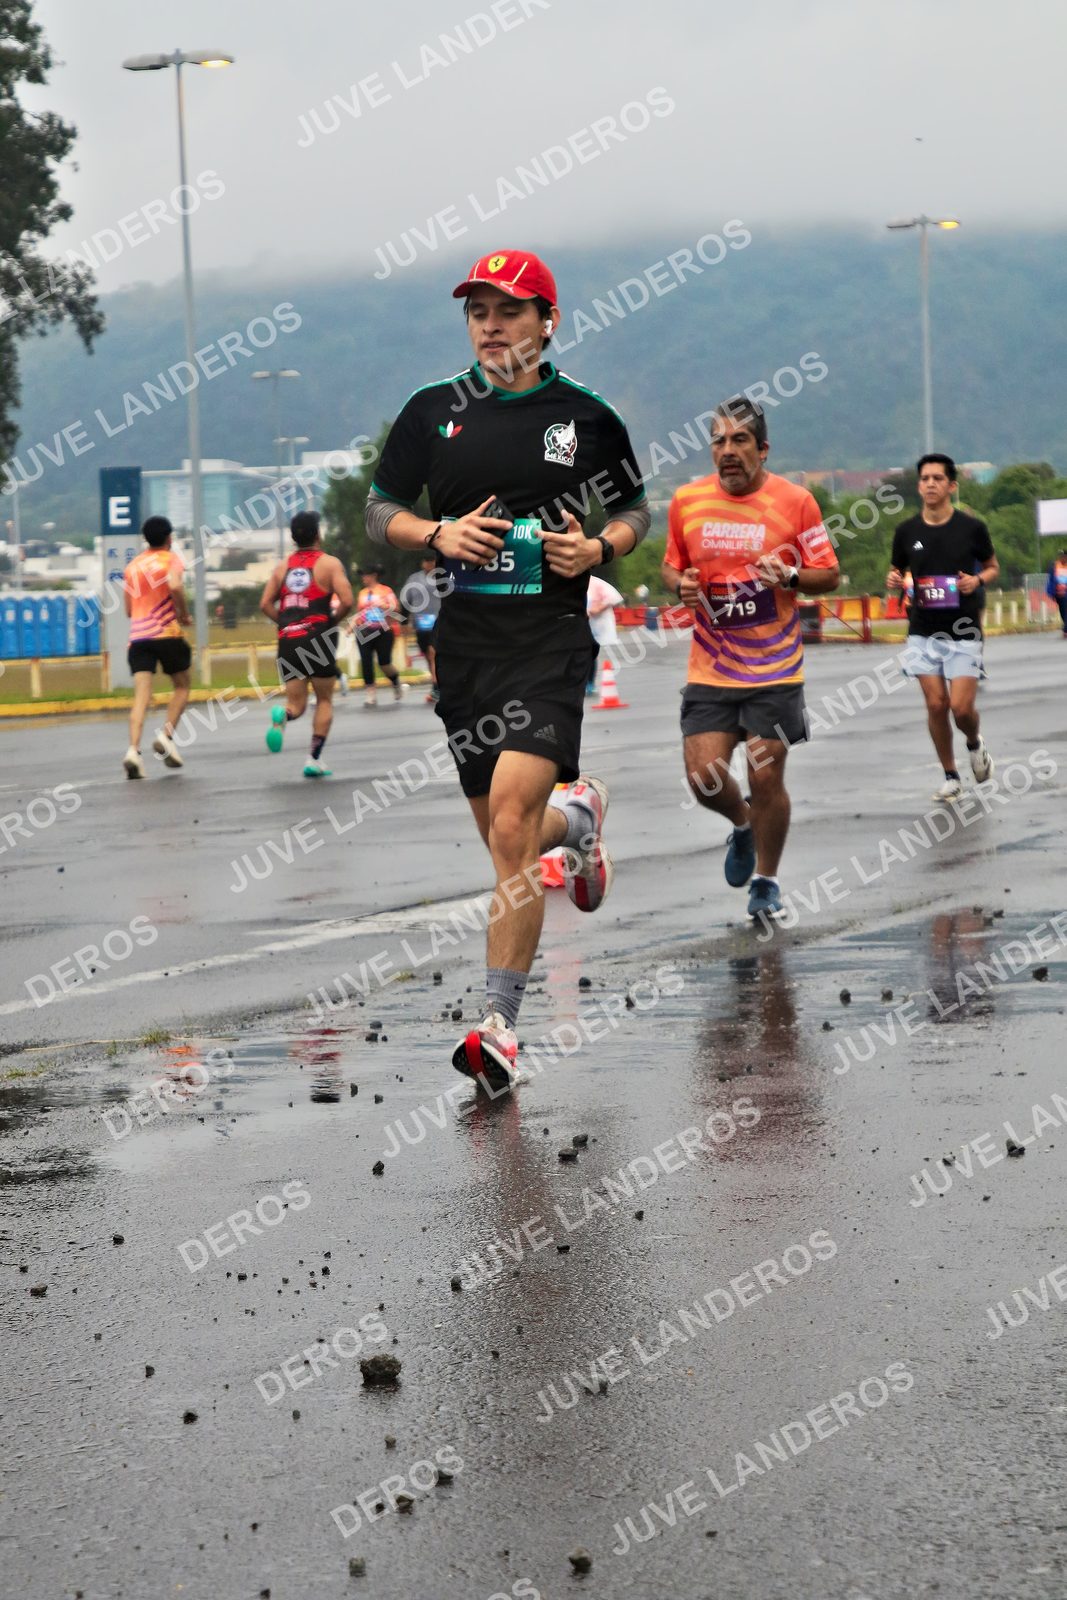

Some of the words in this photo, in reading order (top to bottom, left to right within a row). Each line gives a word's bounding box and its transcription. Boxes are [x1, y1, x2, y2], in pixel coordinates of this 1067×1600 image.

[109, 495, 131, 527] E
[512, 525, 533, 539] 10K
[702, 521, 766, 541] CARRERA
[724, 600, 757, 617] 719
